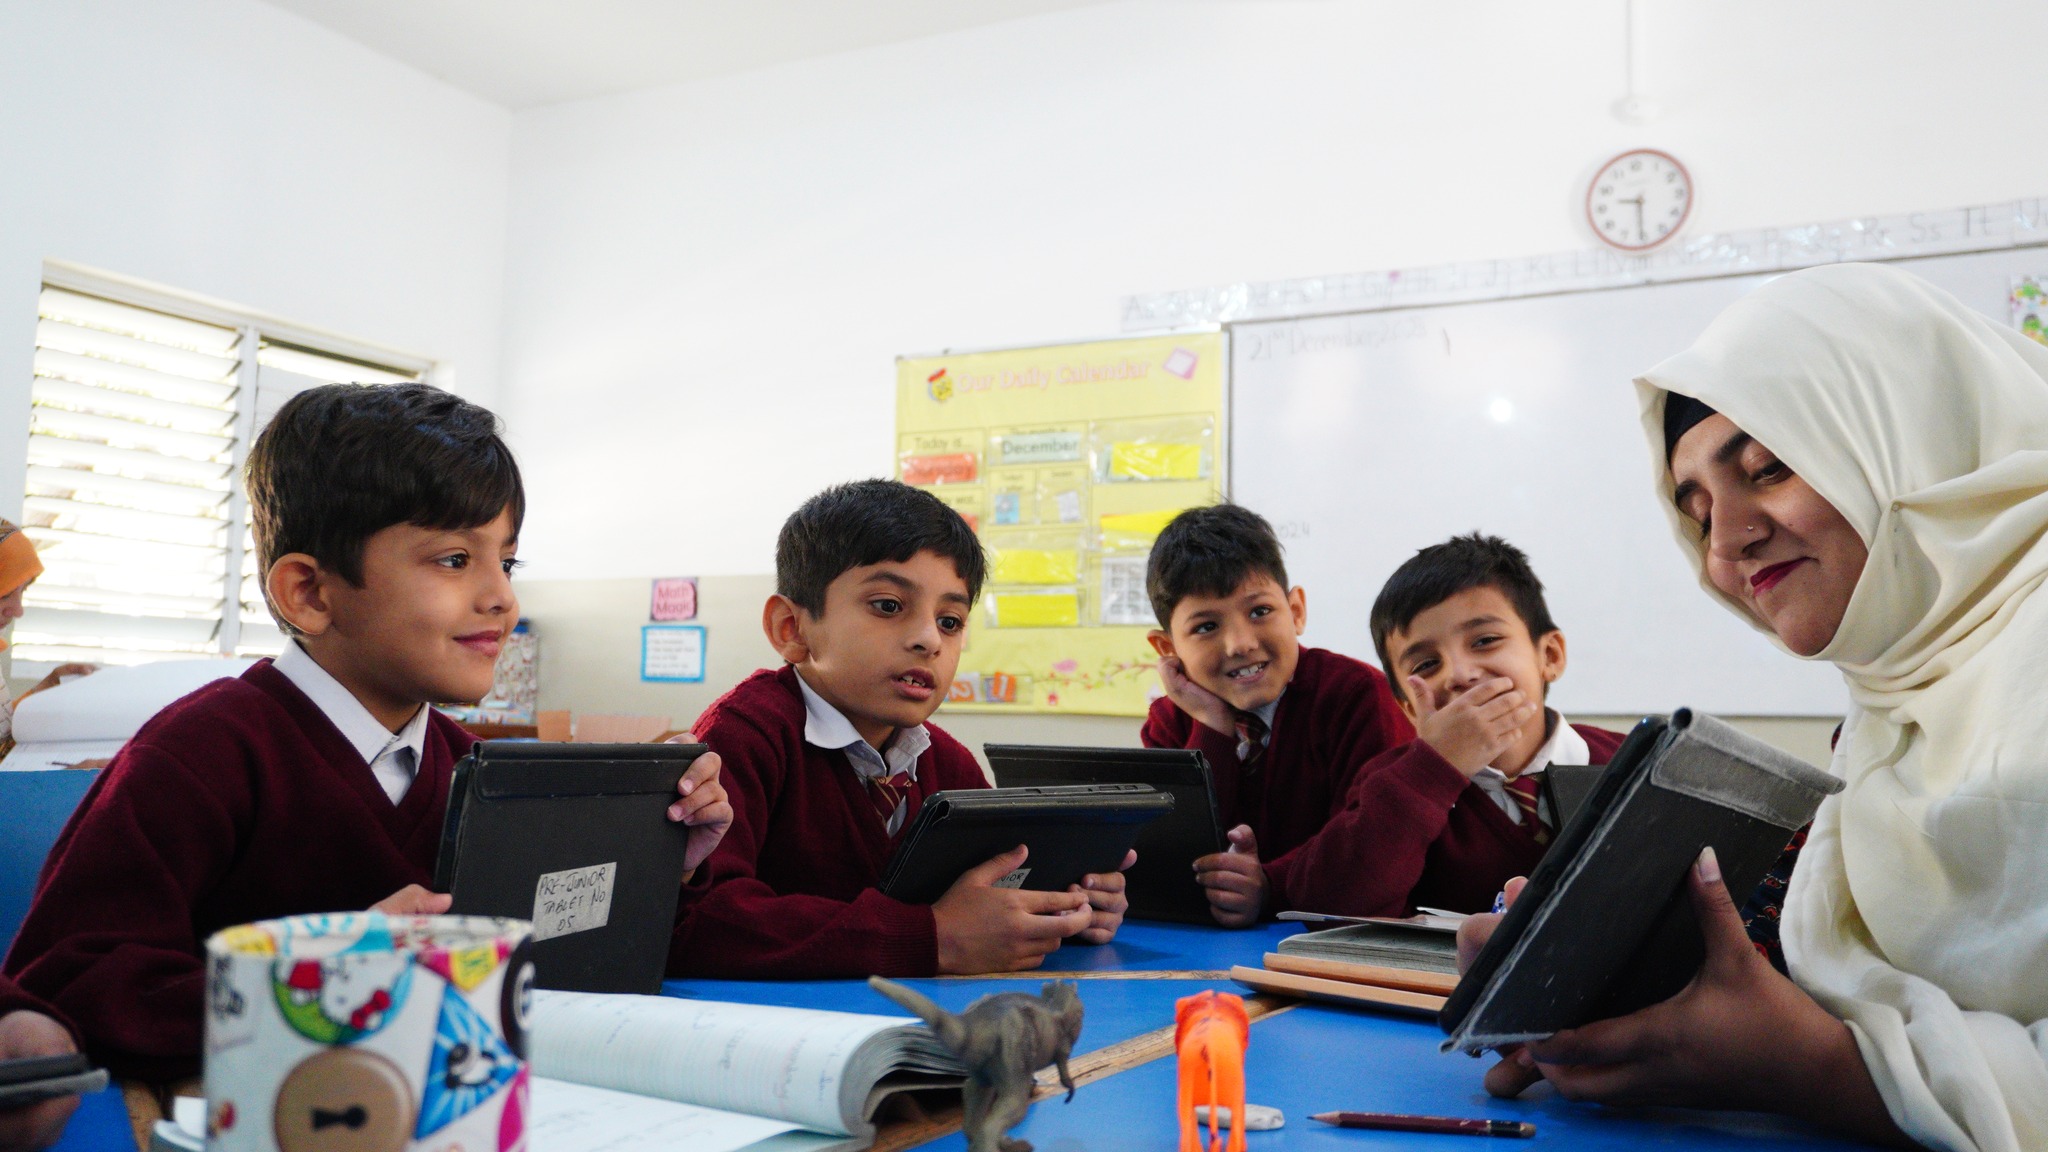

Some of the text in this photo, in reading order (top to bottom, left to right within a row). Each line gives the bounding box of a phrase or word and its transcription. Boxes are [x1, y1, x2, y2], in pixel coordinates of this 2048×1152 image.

[1483, 259, 1511, 295] Jj
[1529, 254, 1558, 281] Kk
[1907, 212, 1942, 244] Ss
[1959, 206, 1992, 238] Tt
[958, 358, 1151, 394] Our Daily Calendar
[914, 436, 949, 453] Today
[1001, 439, 1079, 456] December
[657, 585, 690, 599] Math
[655, 601, 691, 615] Magic
[538, 866, 606, 896] PRE-JUNIOR
[543, 894, 585, 915] TABLET
